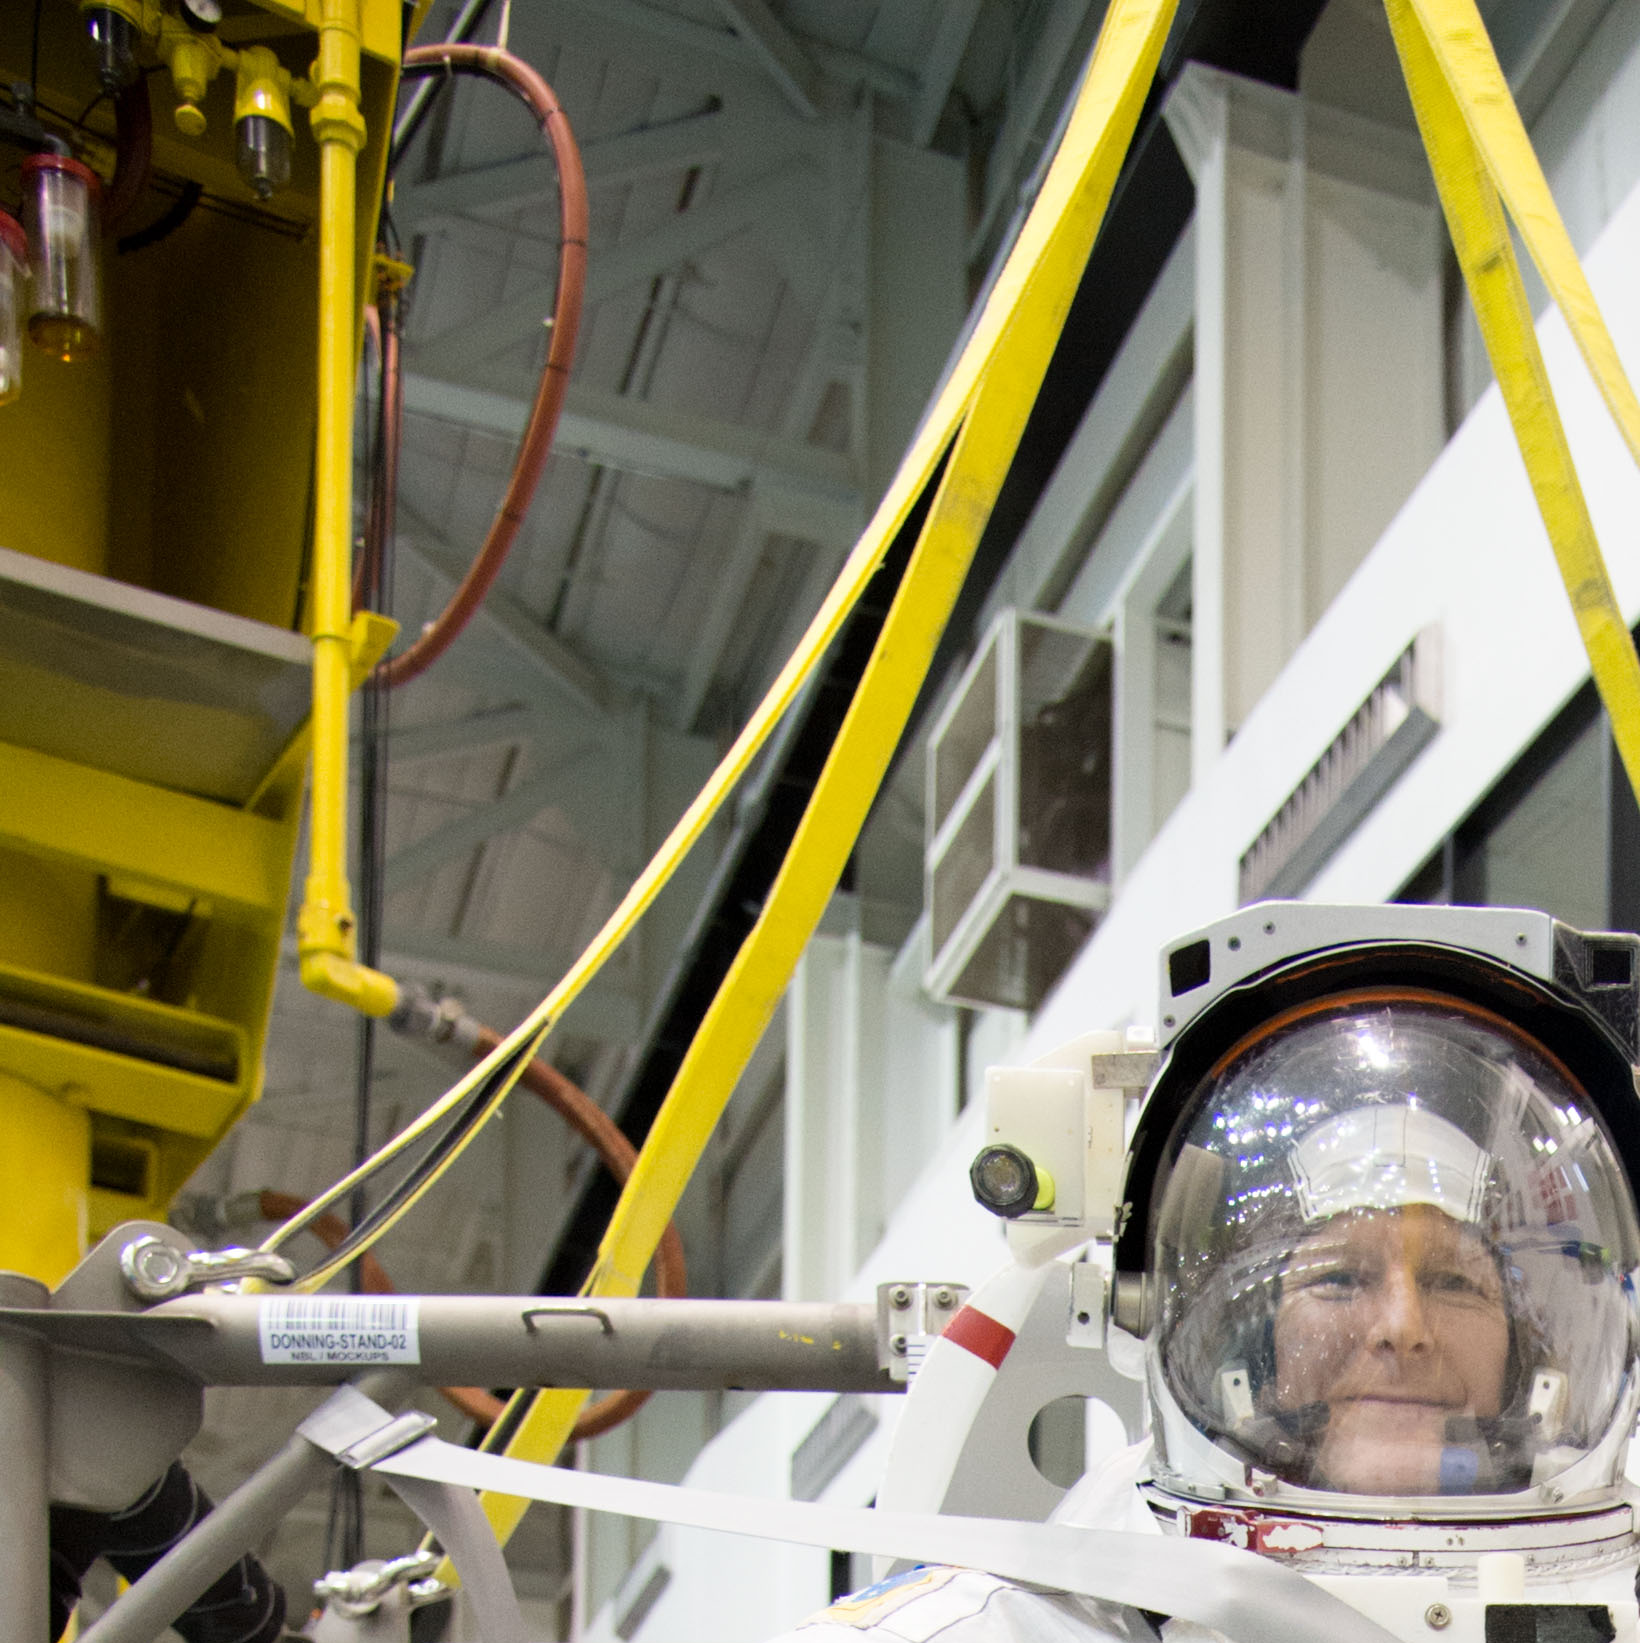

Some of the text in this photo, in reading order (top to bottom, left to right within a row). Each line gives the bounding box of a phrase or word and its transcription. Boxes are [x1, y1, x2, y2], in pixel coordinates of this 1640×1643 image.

[271, 1333, 407, 1349] DONNING-STAND-02
[291, 1352, 317, 1361] NBL
[327, 1352, 390, 1361] MOCKUPS
